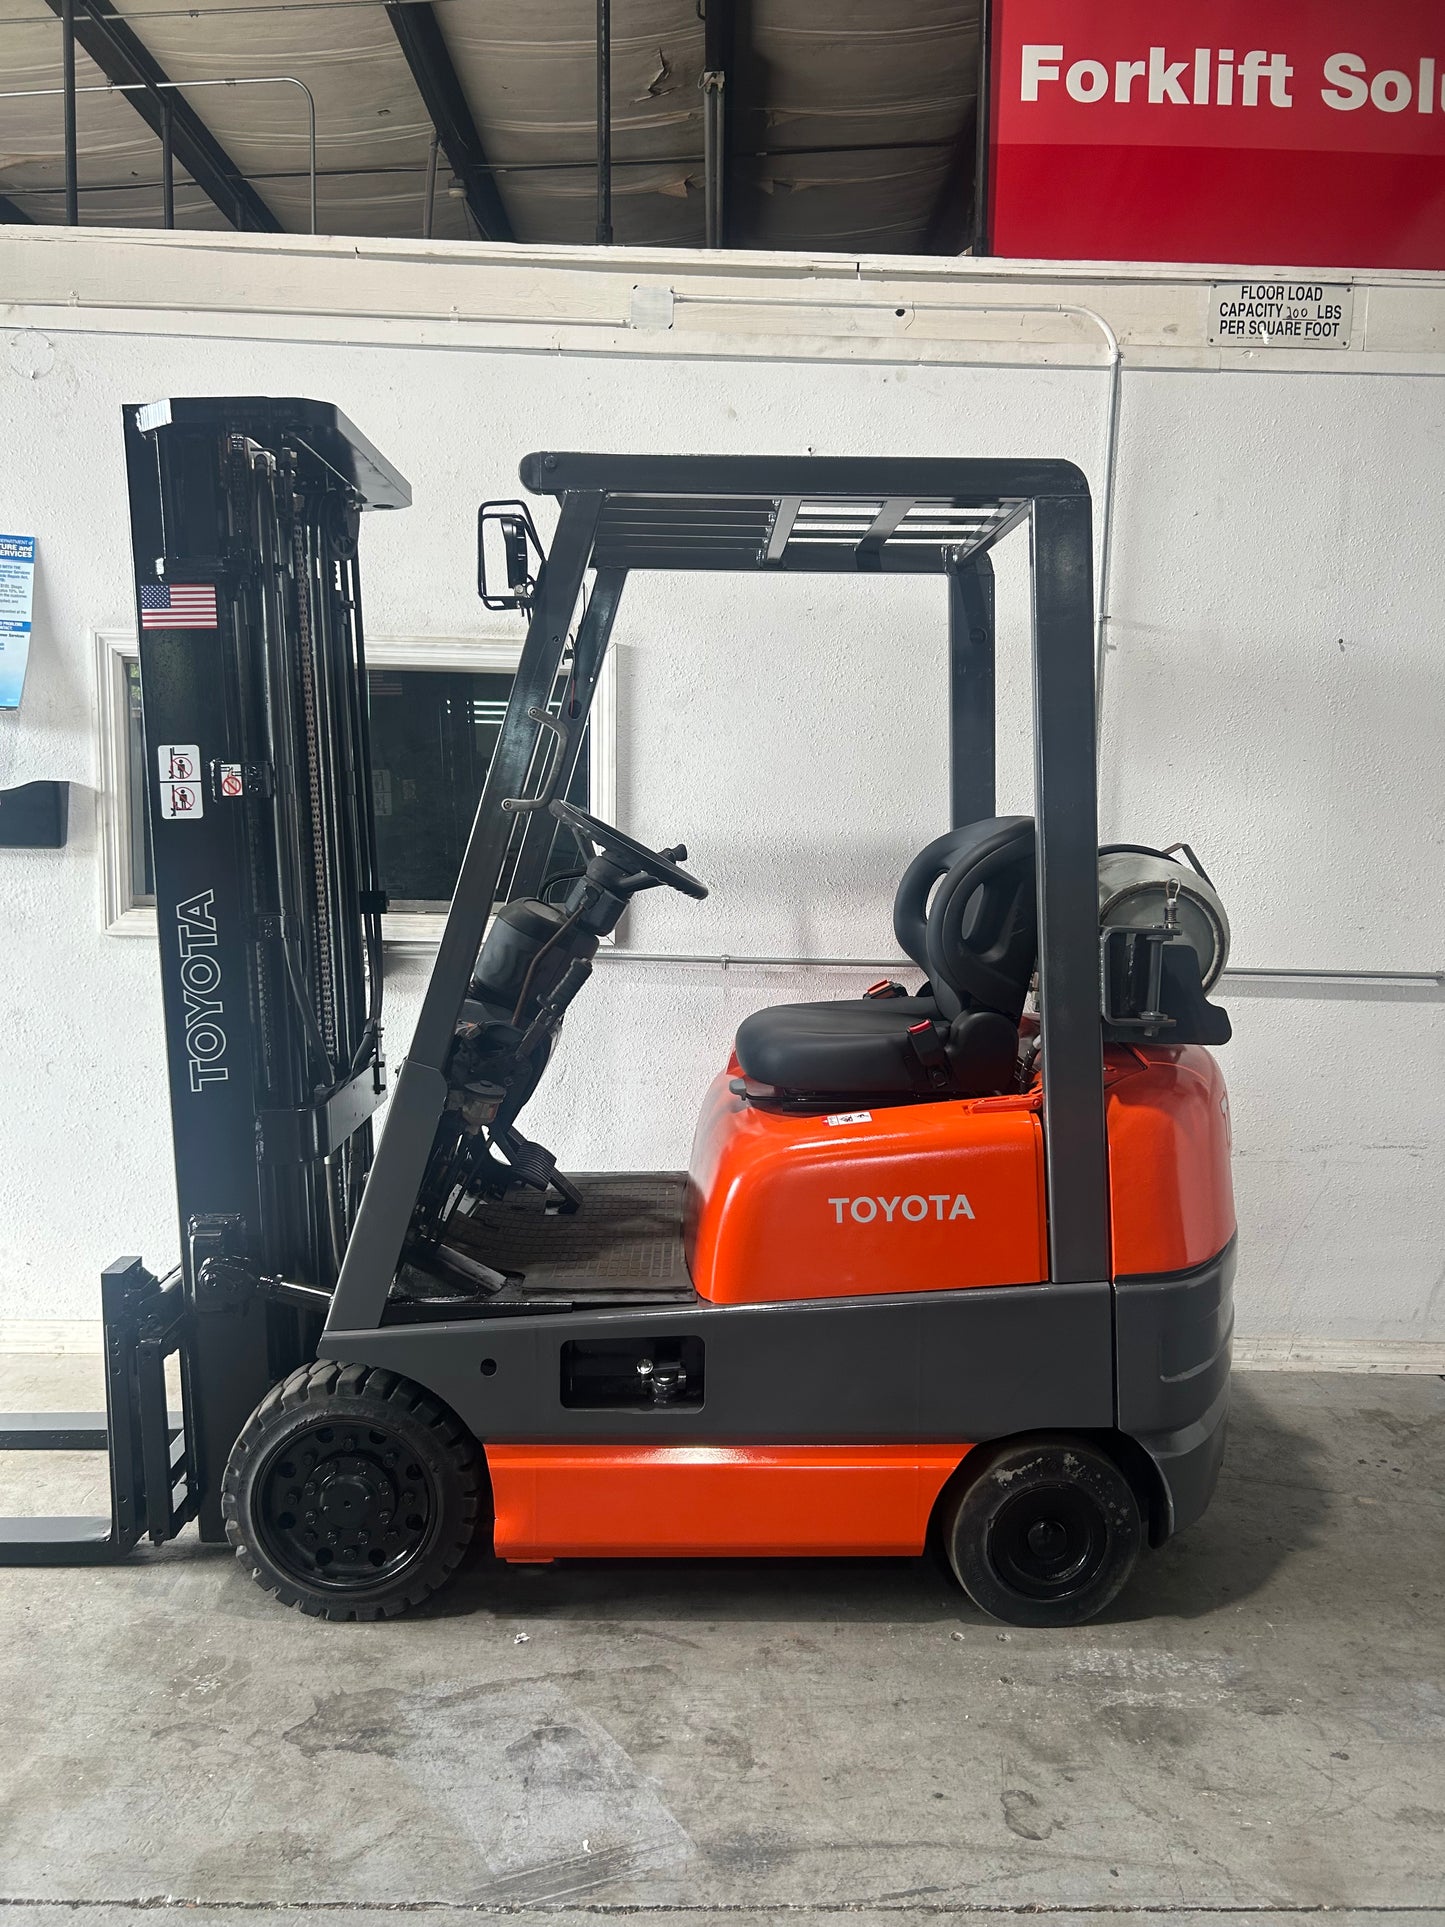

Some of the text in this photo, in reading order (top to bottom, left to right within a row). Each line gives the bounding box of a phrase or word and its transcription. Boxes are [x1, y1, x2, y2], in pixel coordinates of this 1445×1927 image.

[1020, 44, 1445, 114] Forklift Sol
[1241, 285, 1323, 301] FLOOR LOAD
[1219, 302, 1284, 318] CAPACITY
[1317, 304, 1342, 320] LBS
[1219, 320, 1340, 337] PER SQUARE FOOT
[176, 888, 229, 1092] TOYOTA
[828, 1194, 976, 1223] TOYOTA
